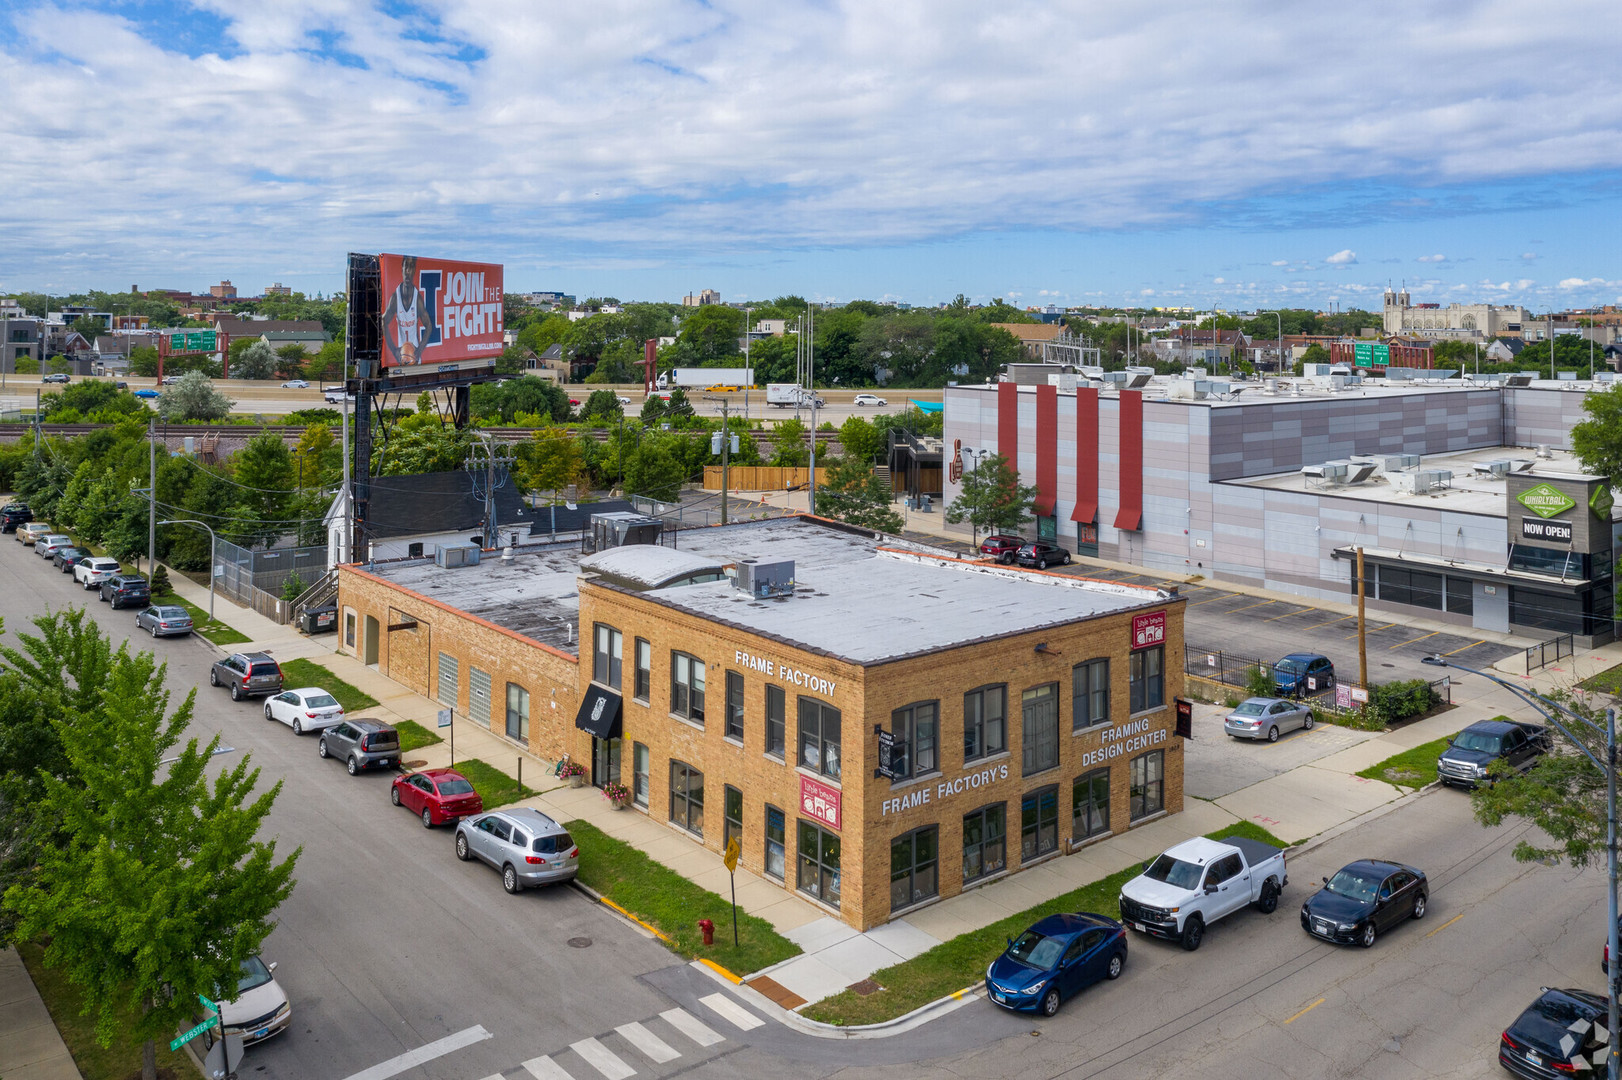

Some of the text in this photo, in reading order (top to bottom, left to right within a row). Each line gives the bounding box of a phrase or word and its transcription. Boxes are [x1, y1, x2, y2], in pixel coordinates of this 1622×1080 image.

[443, 271, 500, 305] JOIN THE
[443, 303, 502, 339] FIGHT!
[1524, 495, 1566, 505] WHIRLYBALL
[1524, 523, 1571, 538] NOW OPEN!
[735, 650, 836, 696] FRAME FACTORY
[1082, 729, 1167, 767] DESIGN CENTER
[1101, 718, 1149, 744] FRAMING
[882, 765, 1009, 816] FRAME FACTORY'S
[180, 1022, 208, 1043] WEBSTER
